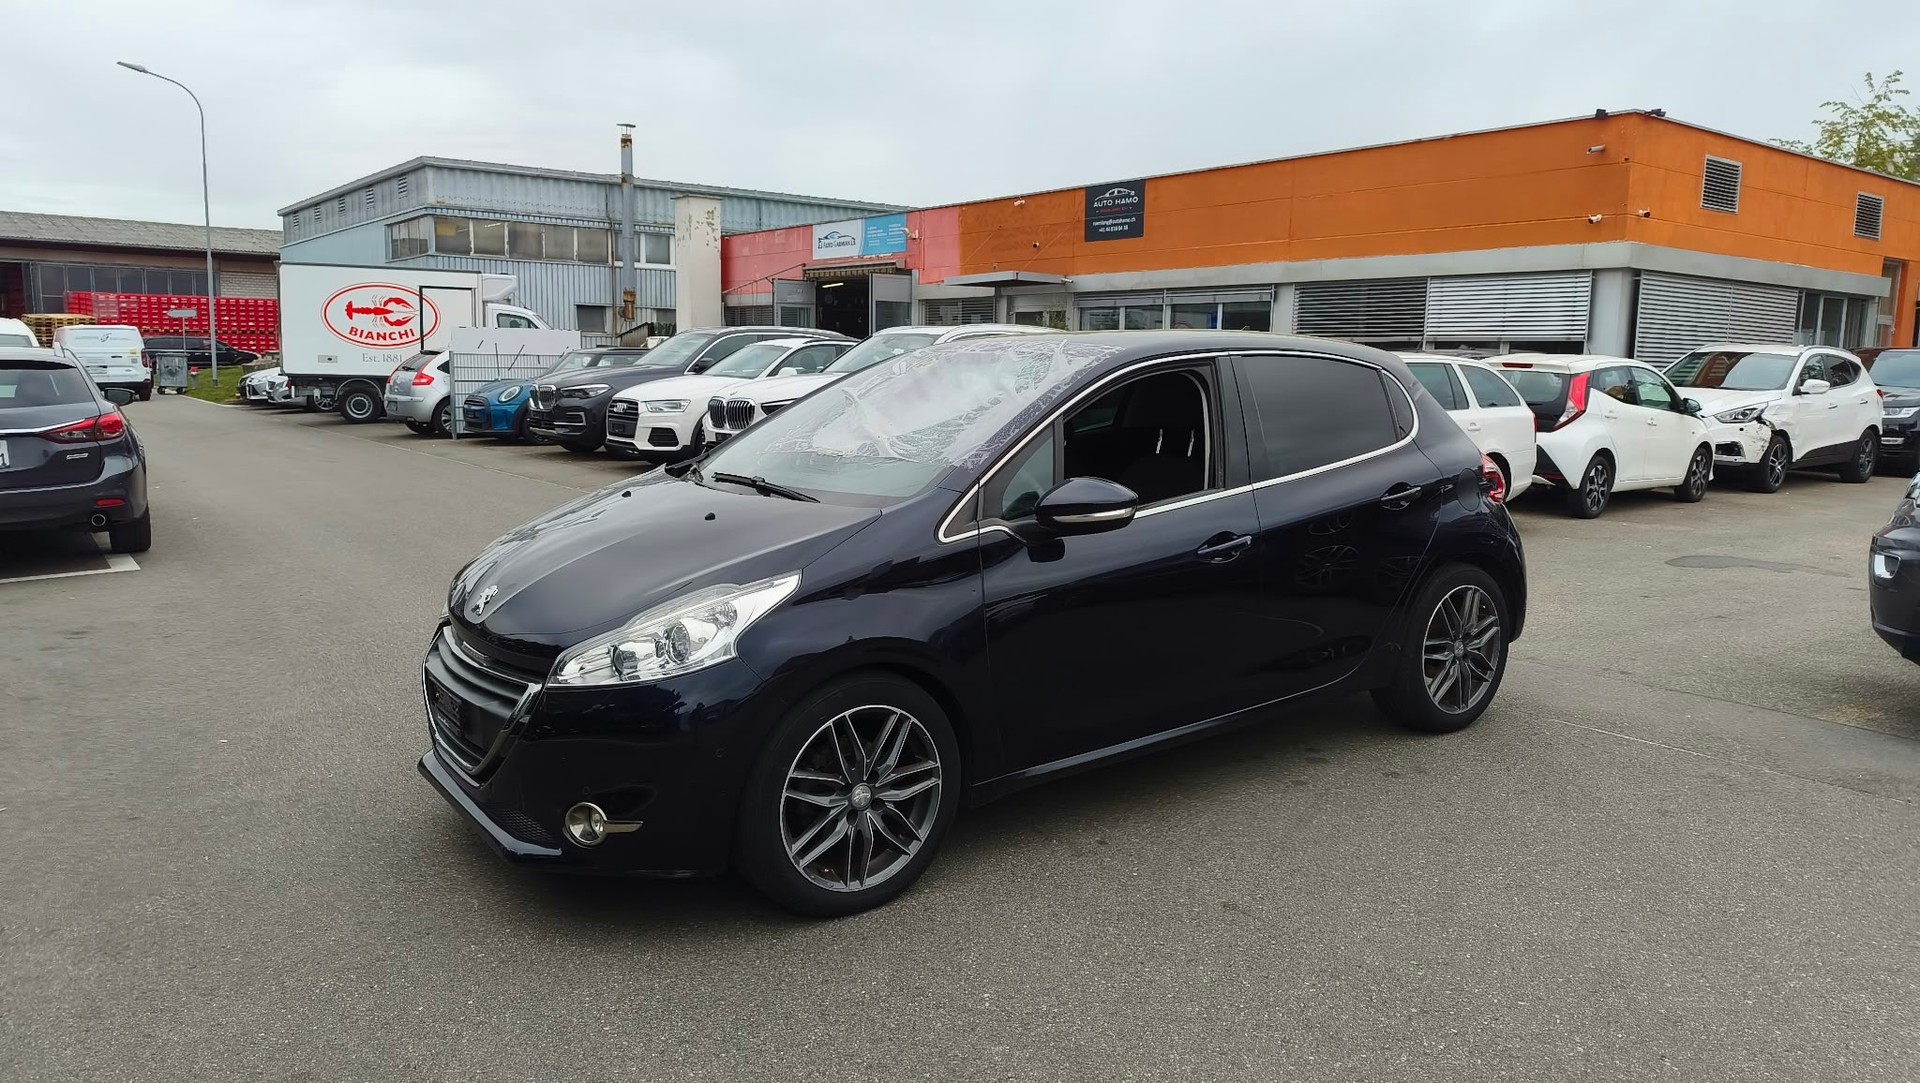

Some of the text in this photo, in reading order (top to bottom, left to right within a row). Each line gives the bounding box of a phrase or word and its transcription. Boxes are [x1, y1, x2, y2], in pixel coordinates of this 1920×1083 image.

[1094, 196, 1138, 208] AUTO HAMO
[349, 326, 415, 341] BIANCHI
[362, 352, 403, 363] Est. 1881
